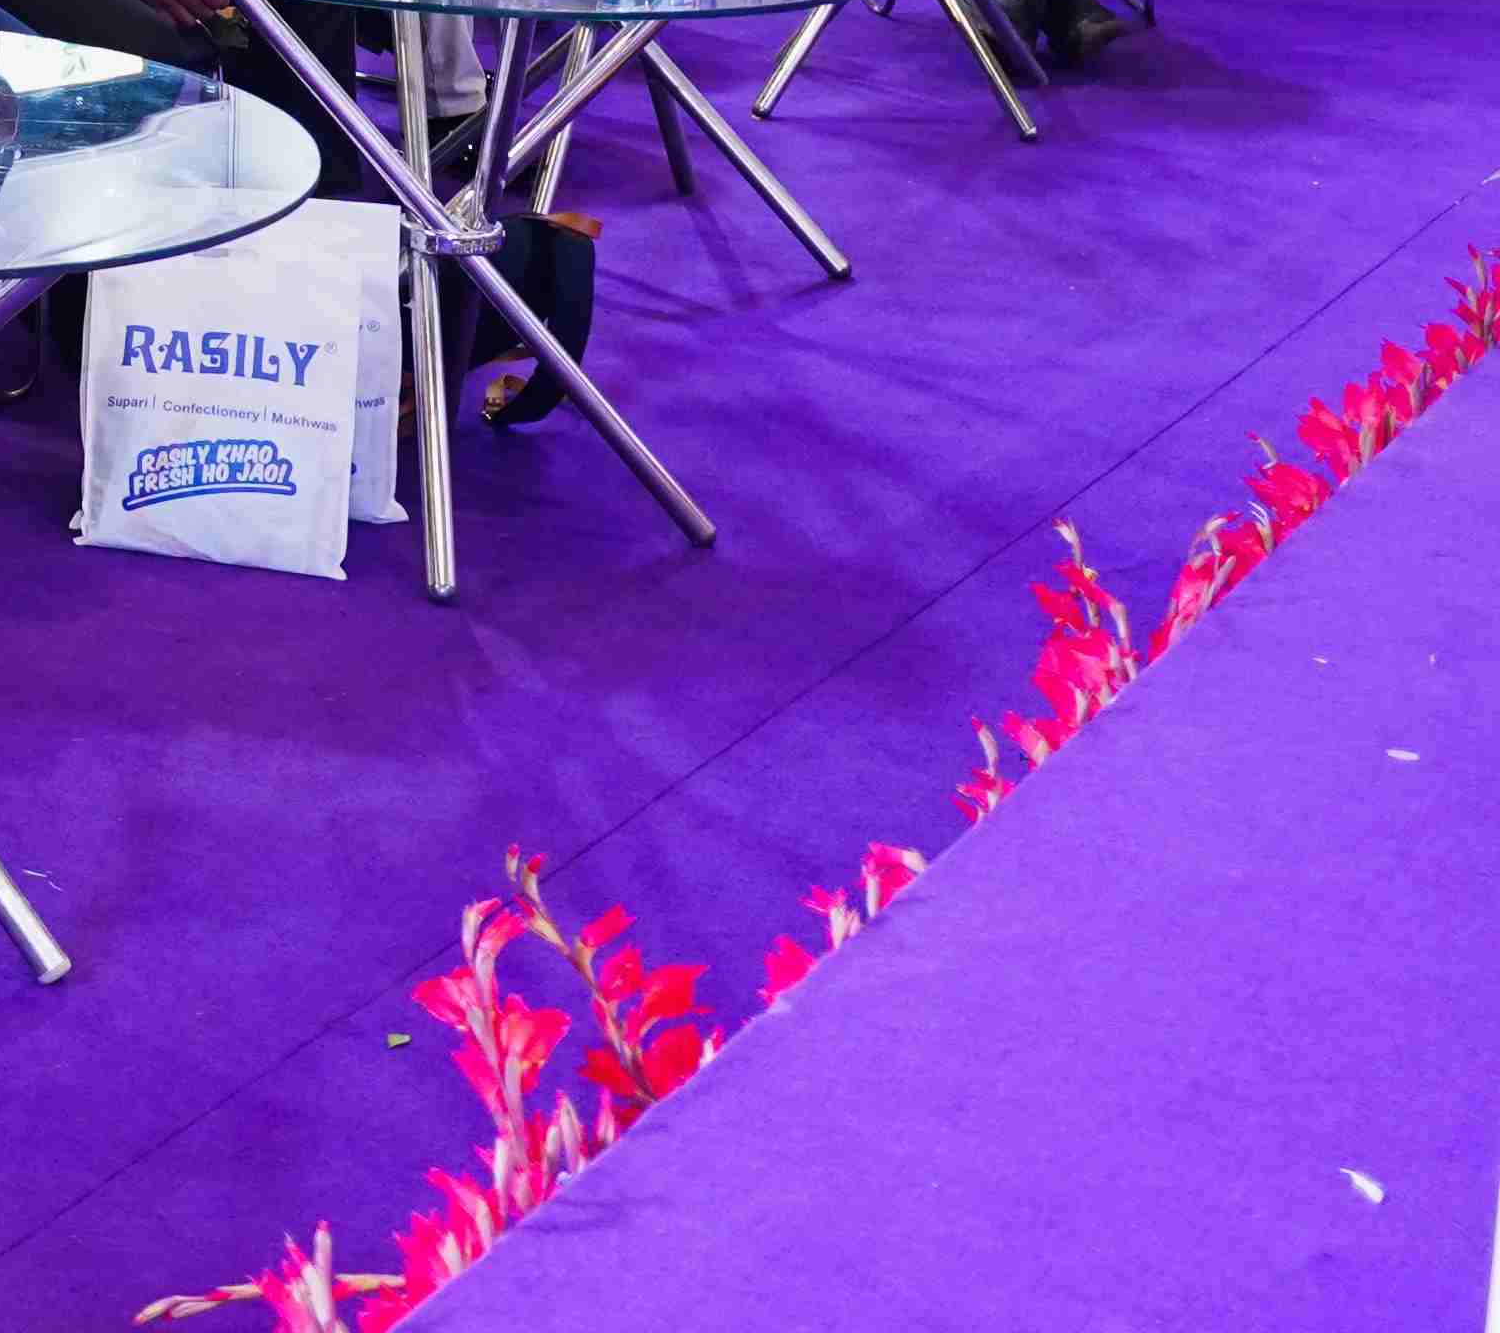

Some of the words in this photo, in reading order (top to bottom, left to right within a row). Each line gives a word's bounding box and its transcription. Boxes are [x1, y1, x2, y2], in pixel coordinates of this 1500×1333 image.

[121, 323, 320, 387] RASILY
[107, 395, 149, 411] Supari
[162, 399, 261, 424] Confectionery
[270, 411, 338, 433] Mukhwas
[355, 395, 387, 411] hwas
[141, 444, 209, 472] RASILY
[216, 442, 274, 464] KHAO
[133, 464, 196, 495] FRESH
[200, 463, 229, 484] HO
[236, 462, 289, 483] JAO!
